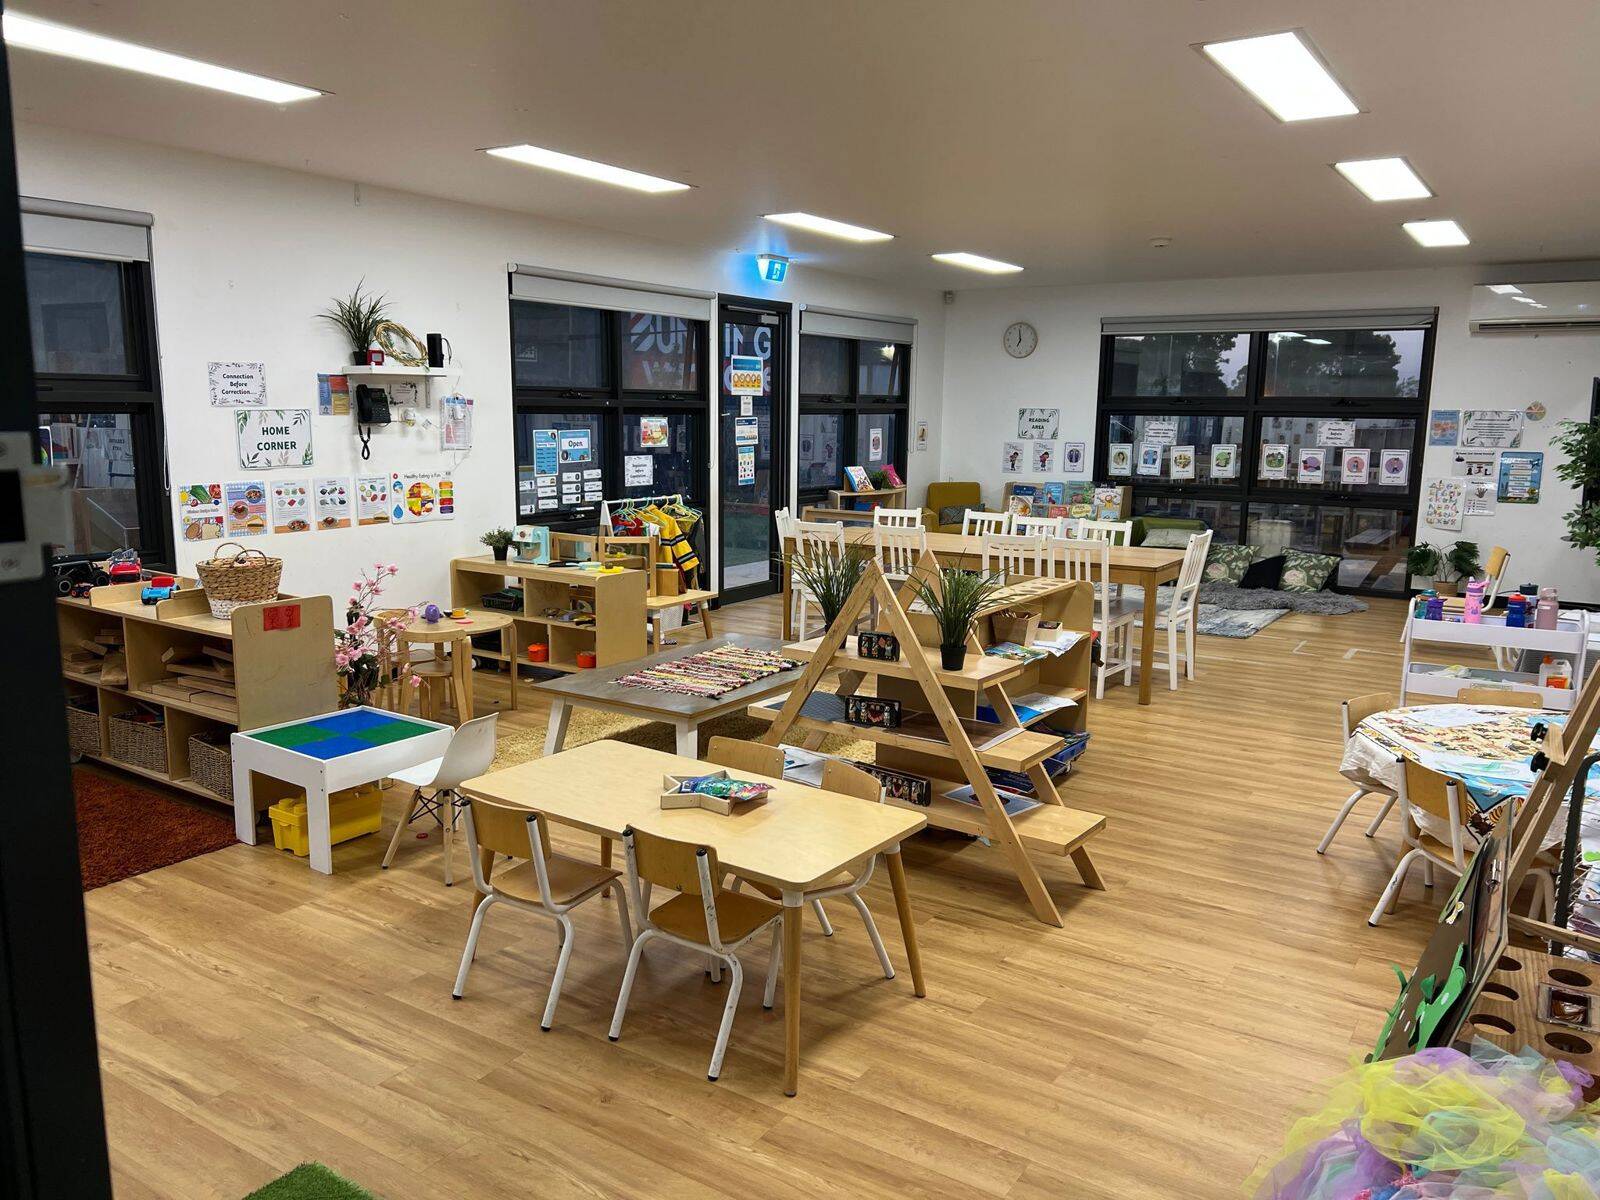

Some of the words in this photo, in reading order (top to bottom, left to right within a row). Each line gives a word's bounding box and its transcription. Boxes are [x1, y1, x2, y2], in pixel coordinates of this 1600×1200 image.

[261, 426, 290, 436] HOME
[256, 440, 297, 451] CORNER
[568, 440, 584, 449] Open
